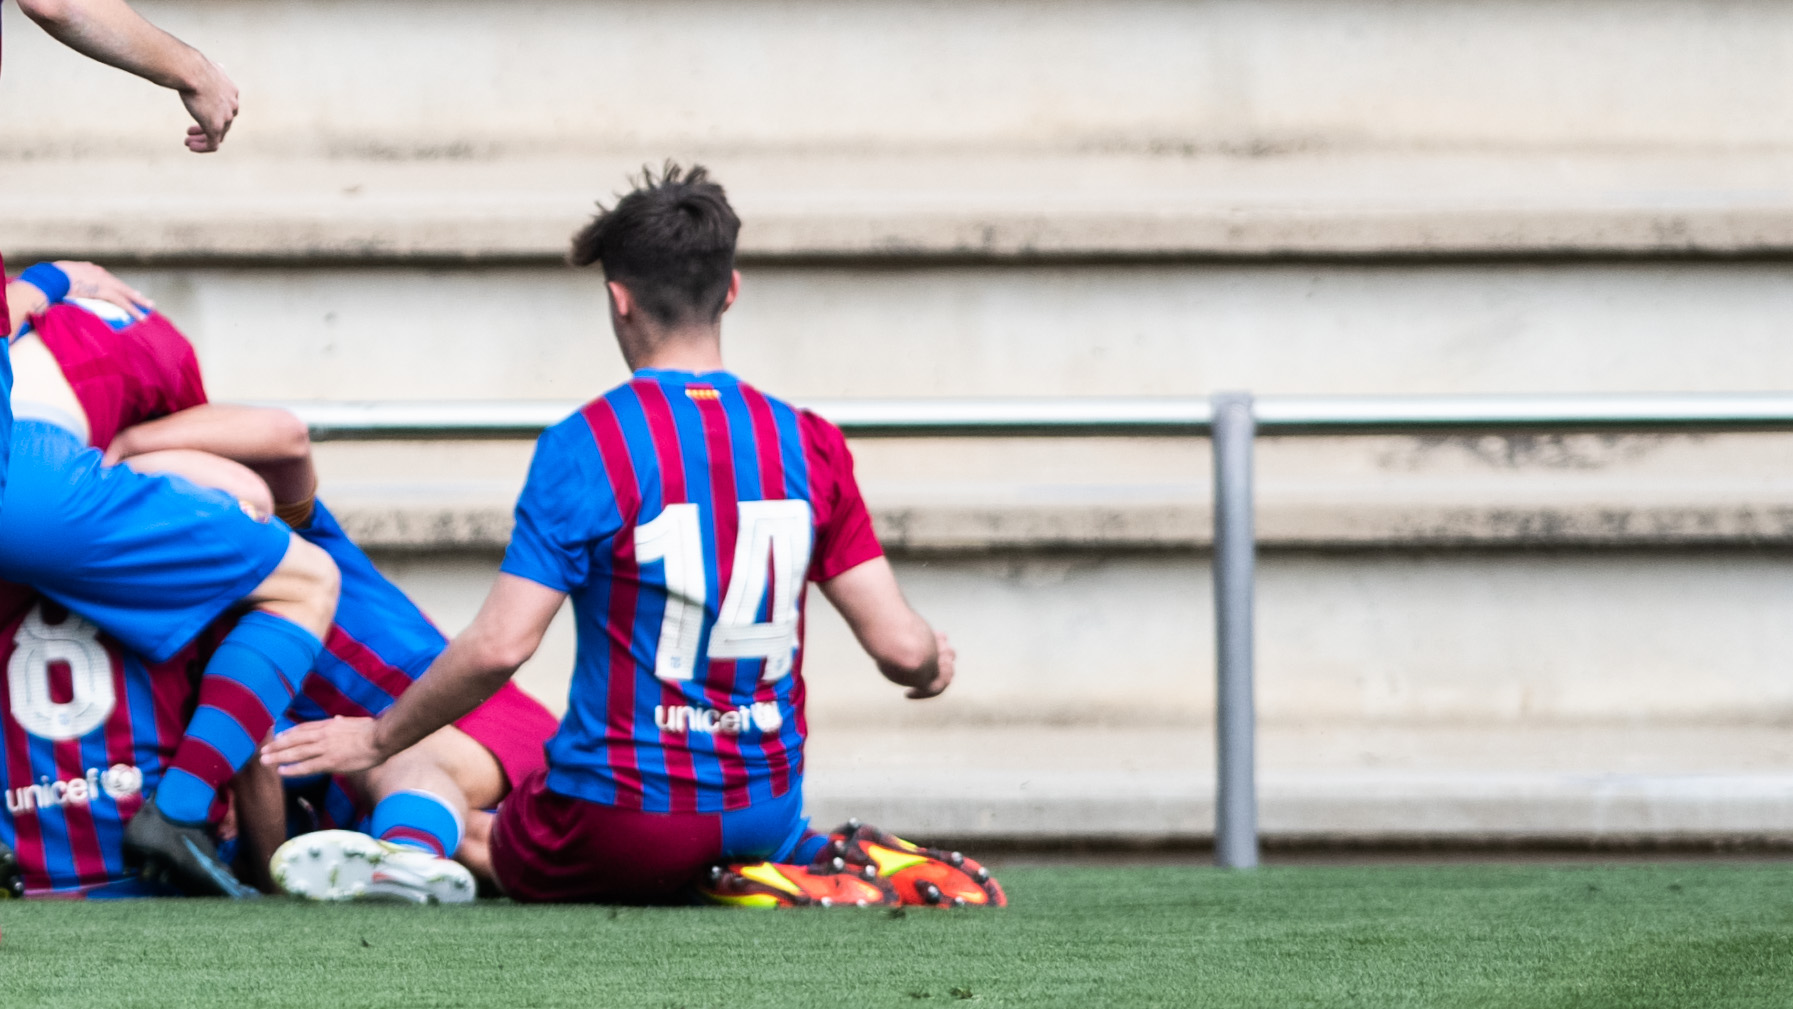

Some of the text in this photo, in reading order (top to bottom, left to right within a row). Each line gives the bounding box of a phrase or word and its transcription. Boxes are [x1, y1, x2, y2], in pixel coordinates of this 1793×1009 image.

[634, 499, 812, 682] 14
[7, 600, 116, 740] 8
[655, 703, 750, 734] unicef
[5, 767, 99, 812] unicef
